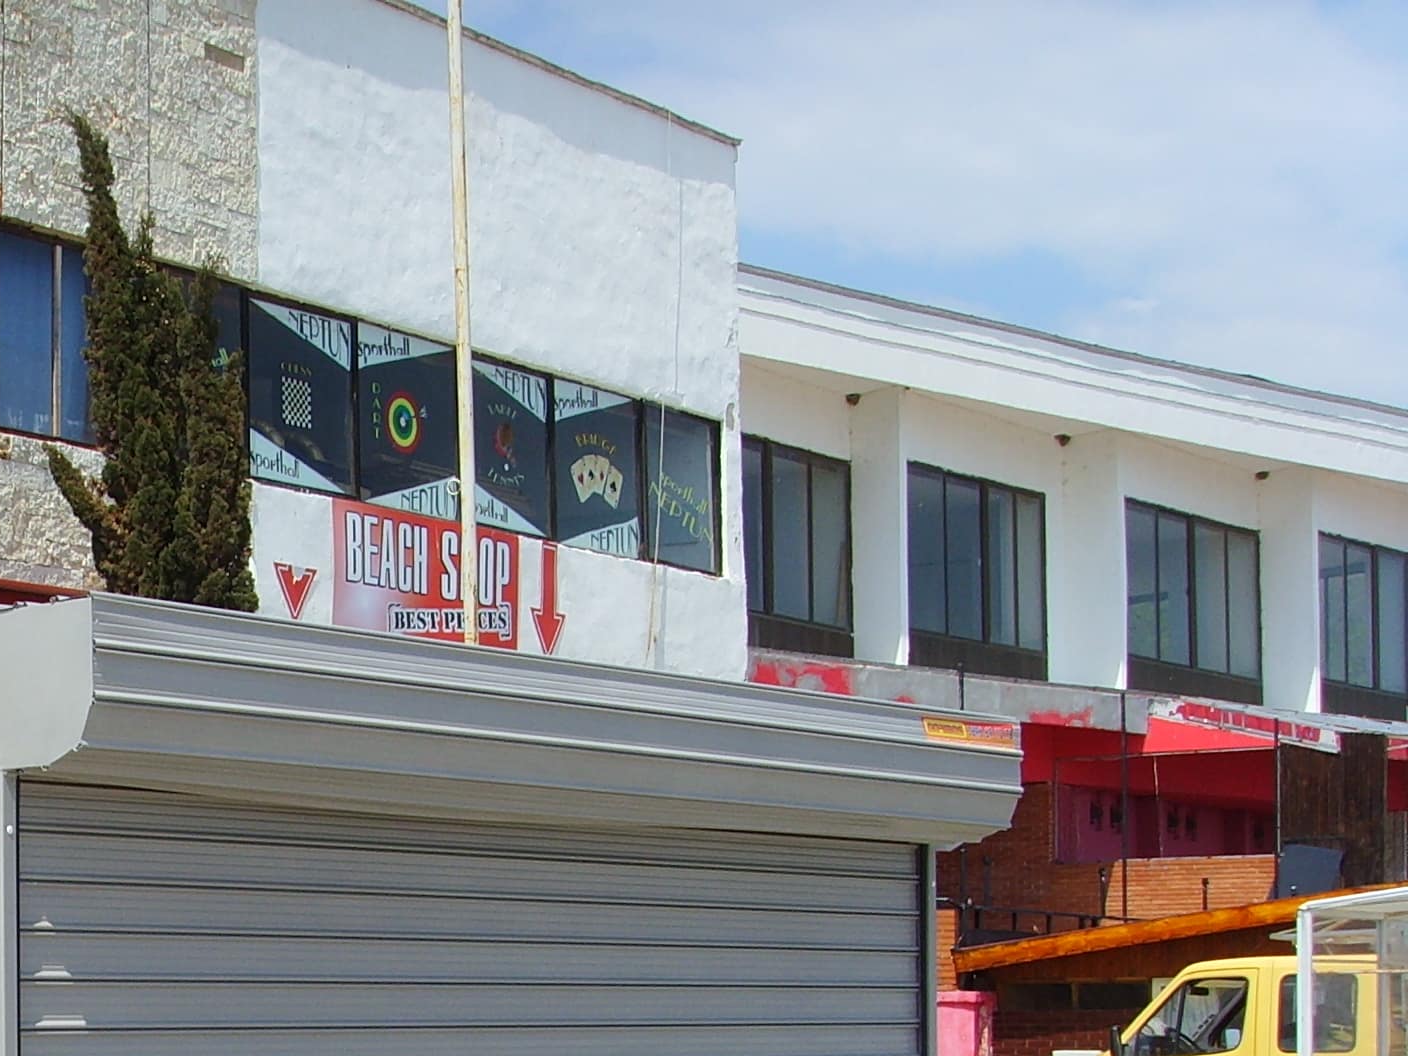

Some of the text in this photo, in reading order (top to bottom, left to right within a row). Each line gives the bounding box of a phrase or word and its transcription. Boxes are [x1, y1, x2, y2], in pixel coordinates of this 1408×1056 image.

[345, 511, 510, 608] BEACH SOP
[395, 612, 507, 630] BEST PCES
